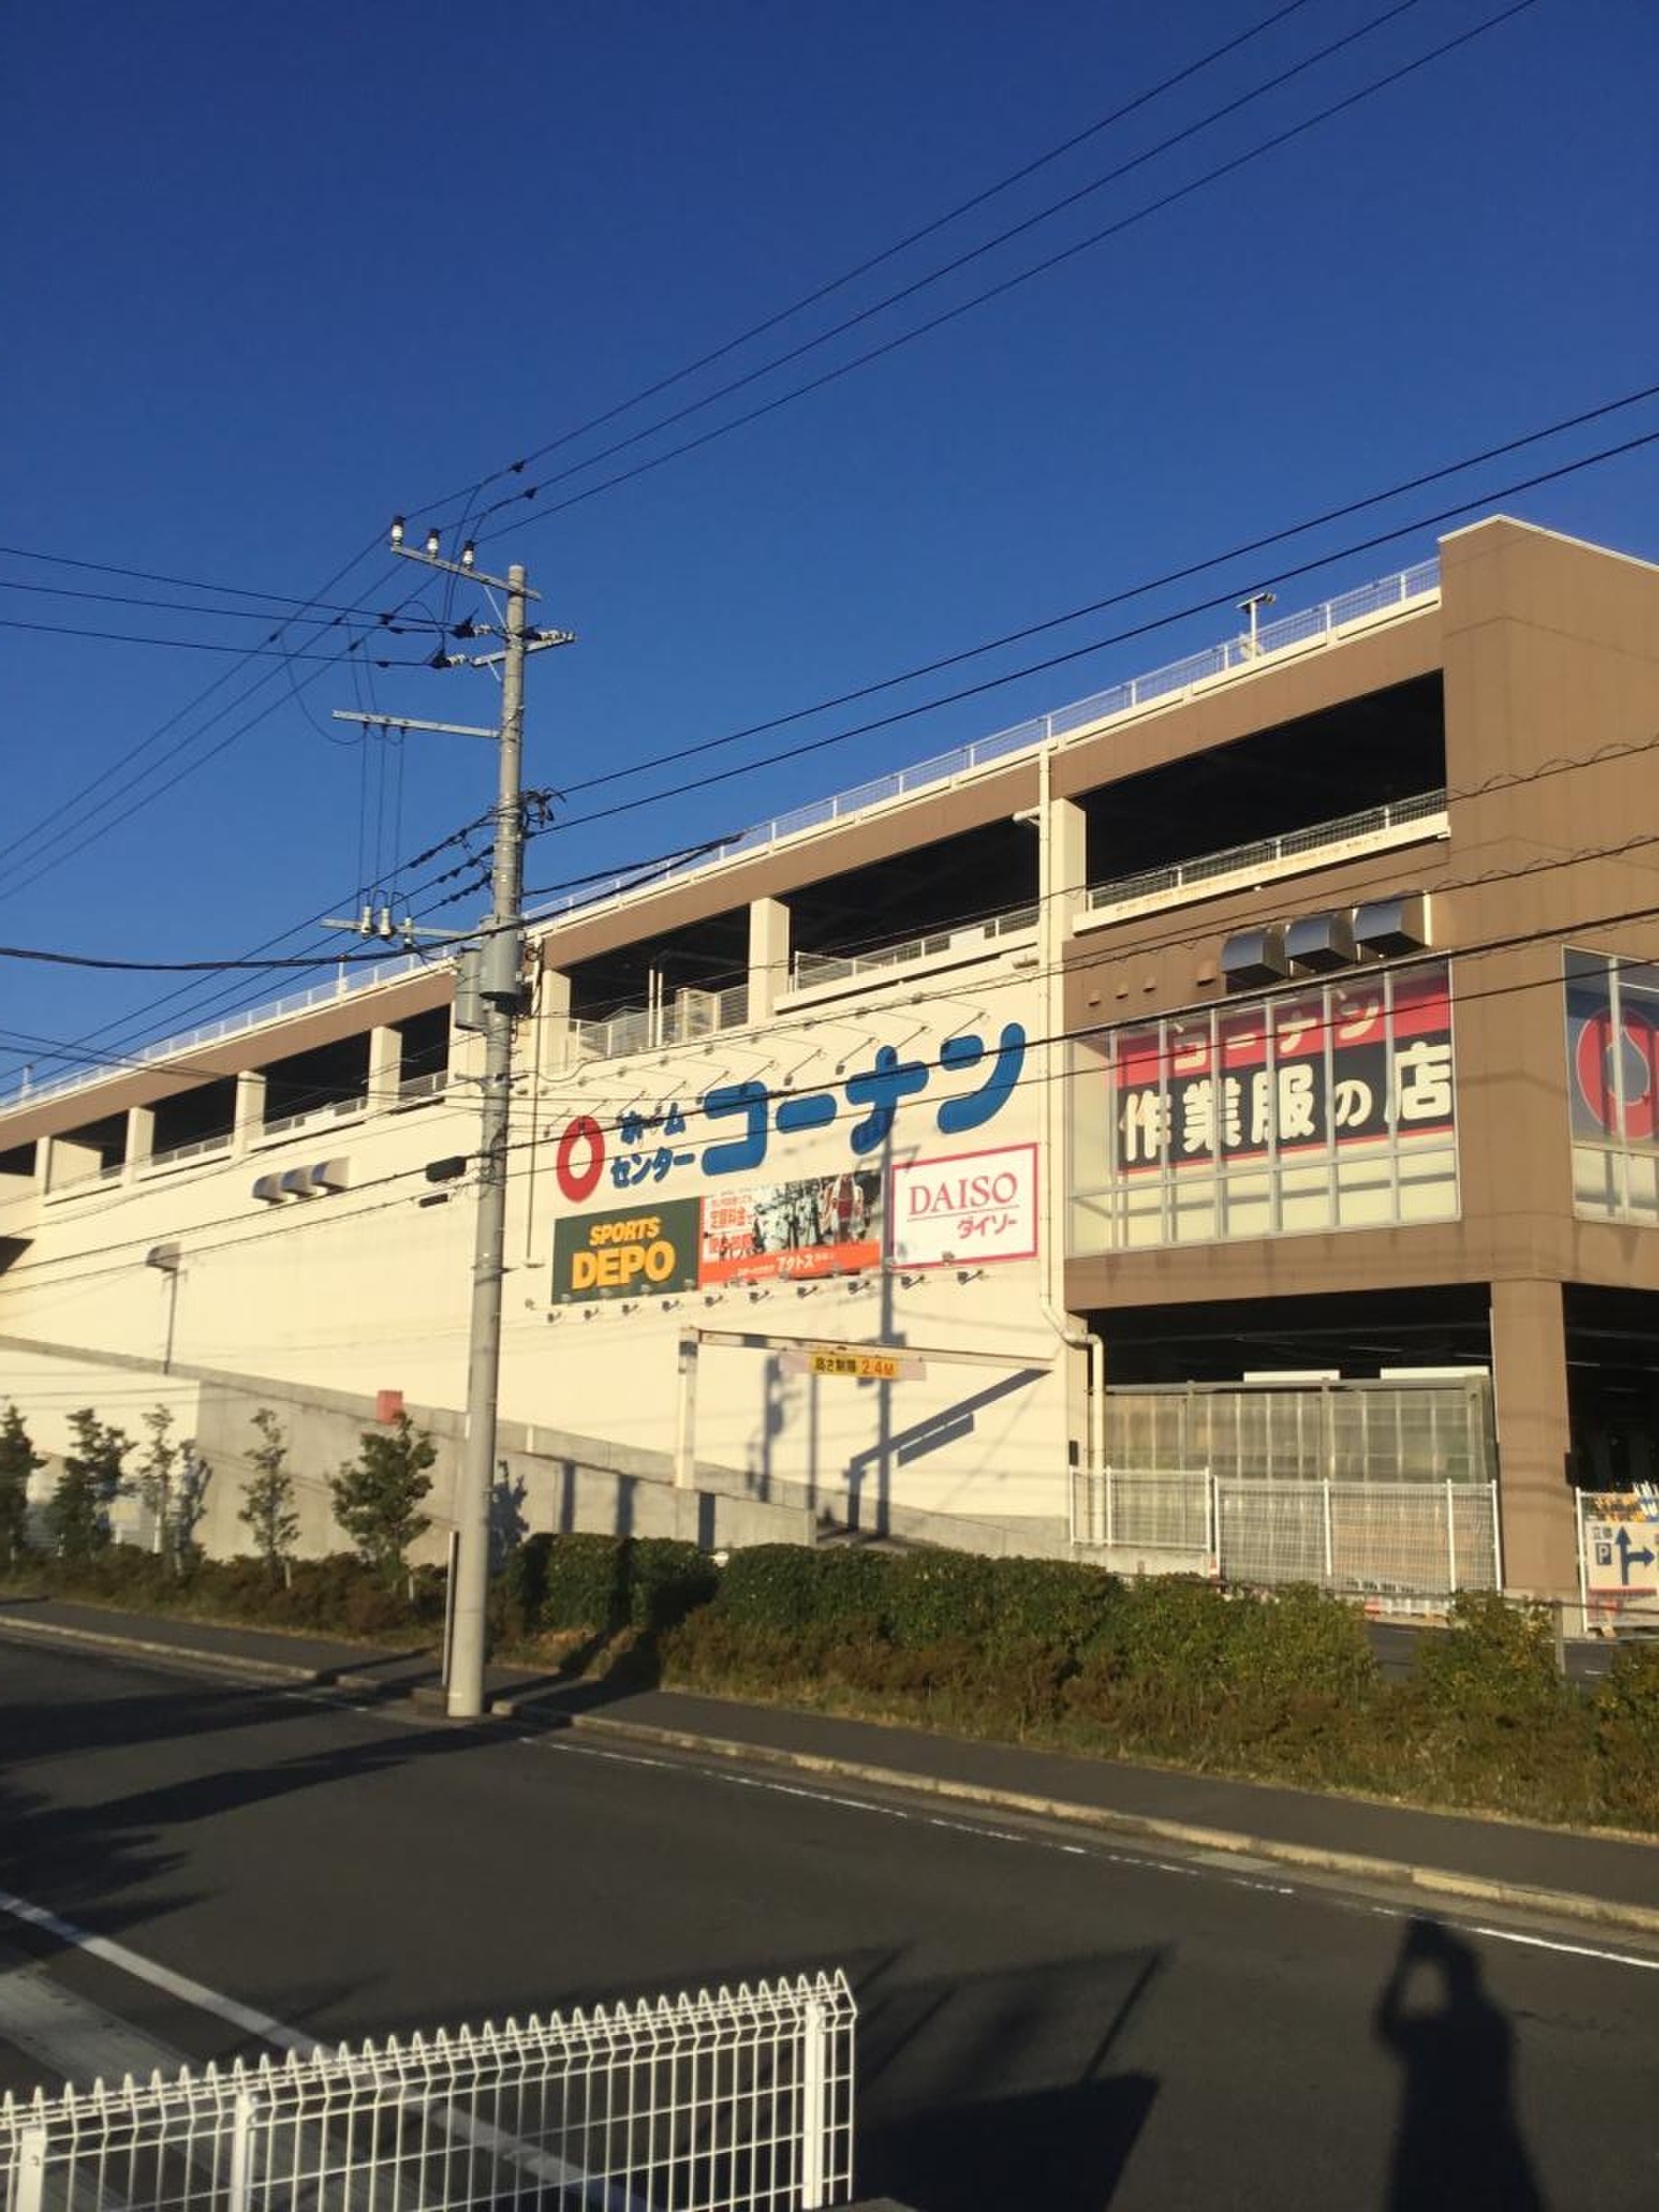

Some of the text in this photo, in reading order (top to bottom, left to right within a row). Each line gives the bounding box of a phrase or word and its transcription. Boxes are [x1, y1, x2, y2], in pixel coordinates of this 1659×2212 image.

[700, 1021, 1027, 1176] コーナン
[1119, 1041, 1453, 1162] 作業服の店
[610, 1147, 696, 1189] センター
[909, 1171, 1018, 1215] DAISO
[590, 1216, 662, 1246] SPORTS
[957, 1212, 1018, 1240] ダイソー
[571, 1240, 676, 1290] DEPO
